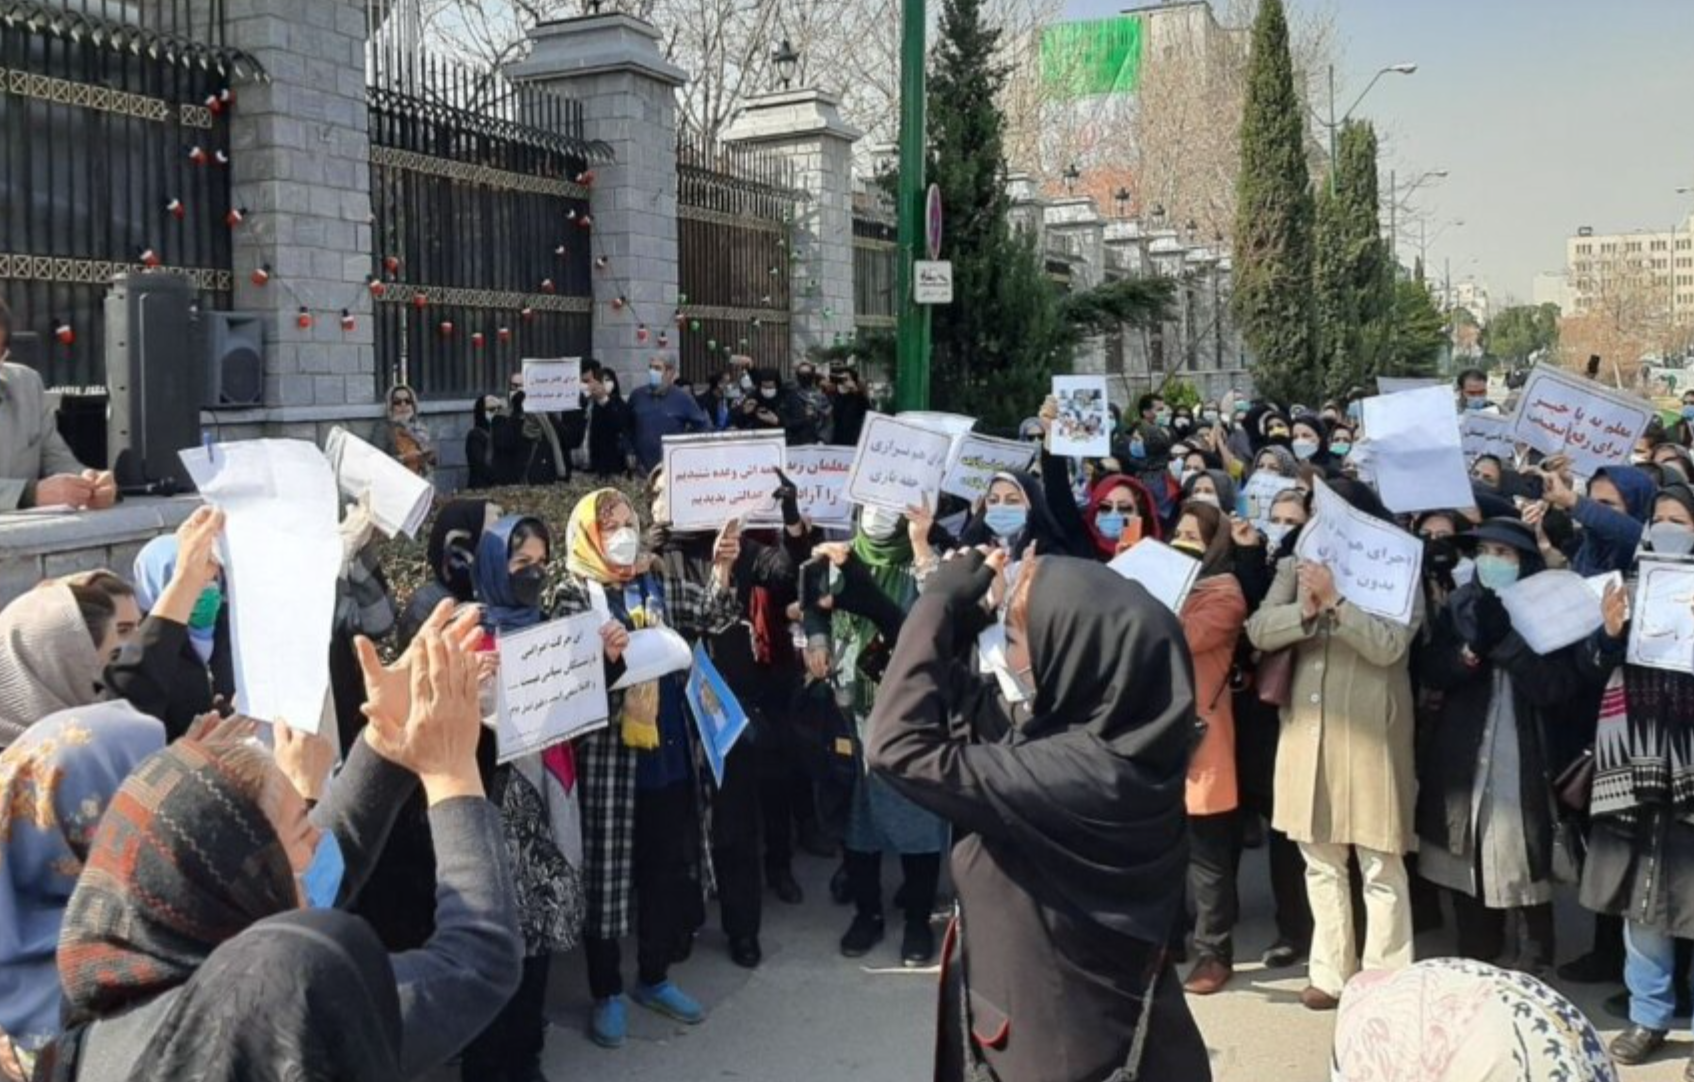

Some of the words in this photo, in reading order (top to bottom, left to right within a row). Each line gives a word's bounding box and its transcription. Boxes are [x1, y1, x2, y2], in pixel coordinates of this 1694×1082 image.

[1588, 415, 1604, 432] به
[1603, 420, 1633, 438] معلم
[1591, 439, 1623, 459] برای
[675, 466, 710, 483] شنیدیم
[713, 467, 738, 481] وعده
[691, 492, 726, 508] ندیدیم
[828, 486, 838, 506] را
[1366, 545, 1412, 567] اجرای
[1356, 576, 1395, 592] بدون
